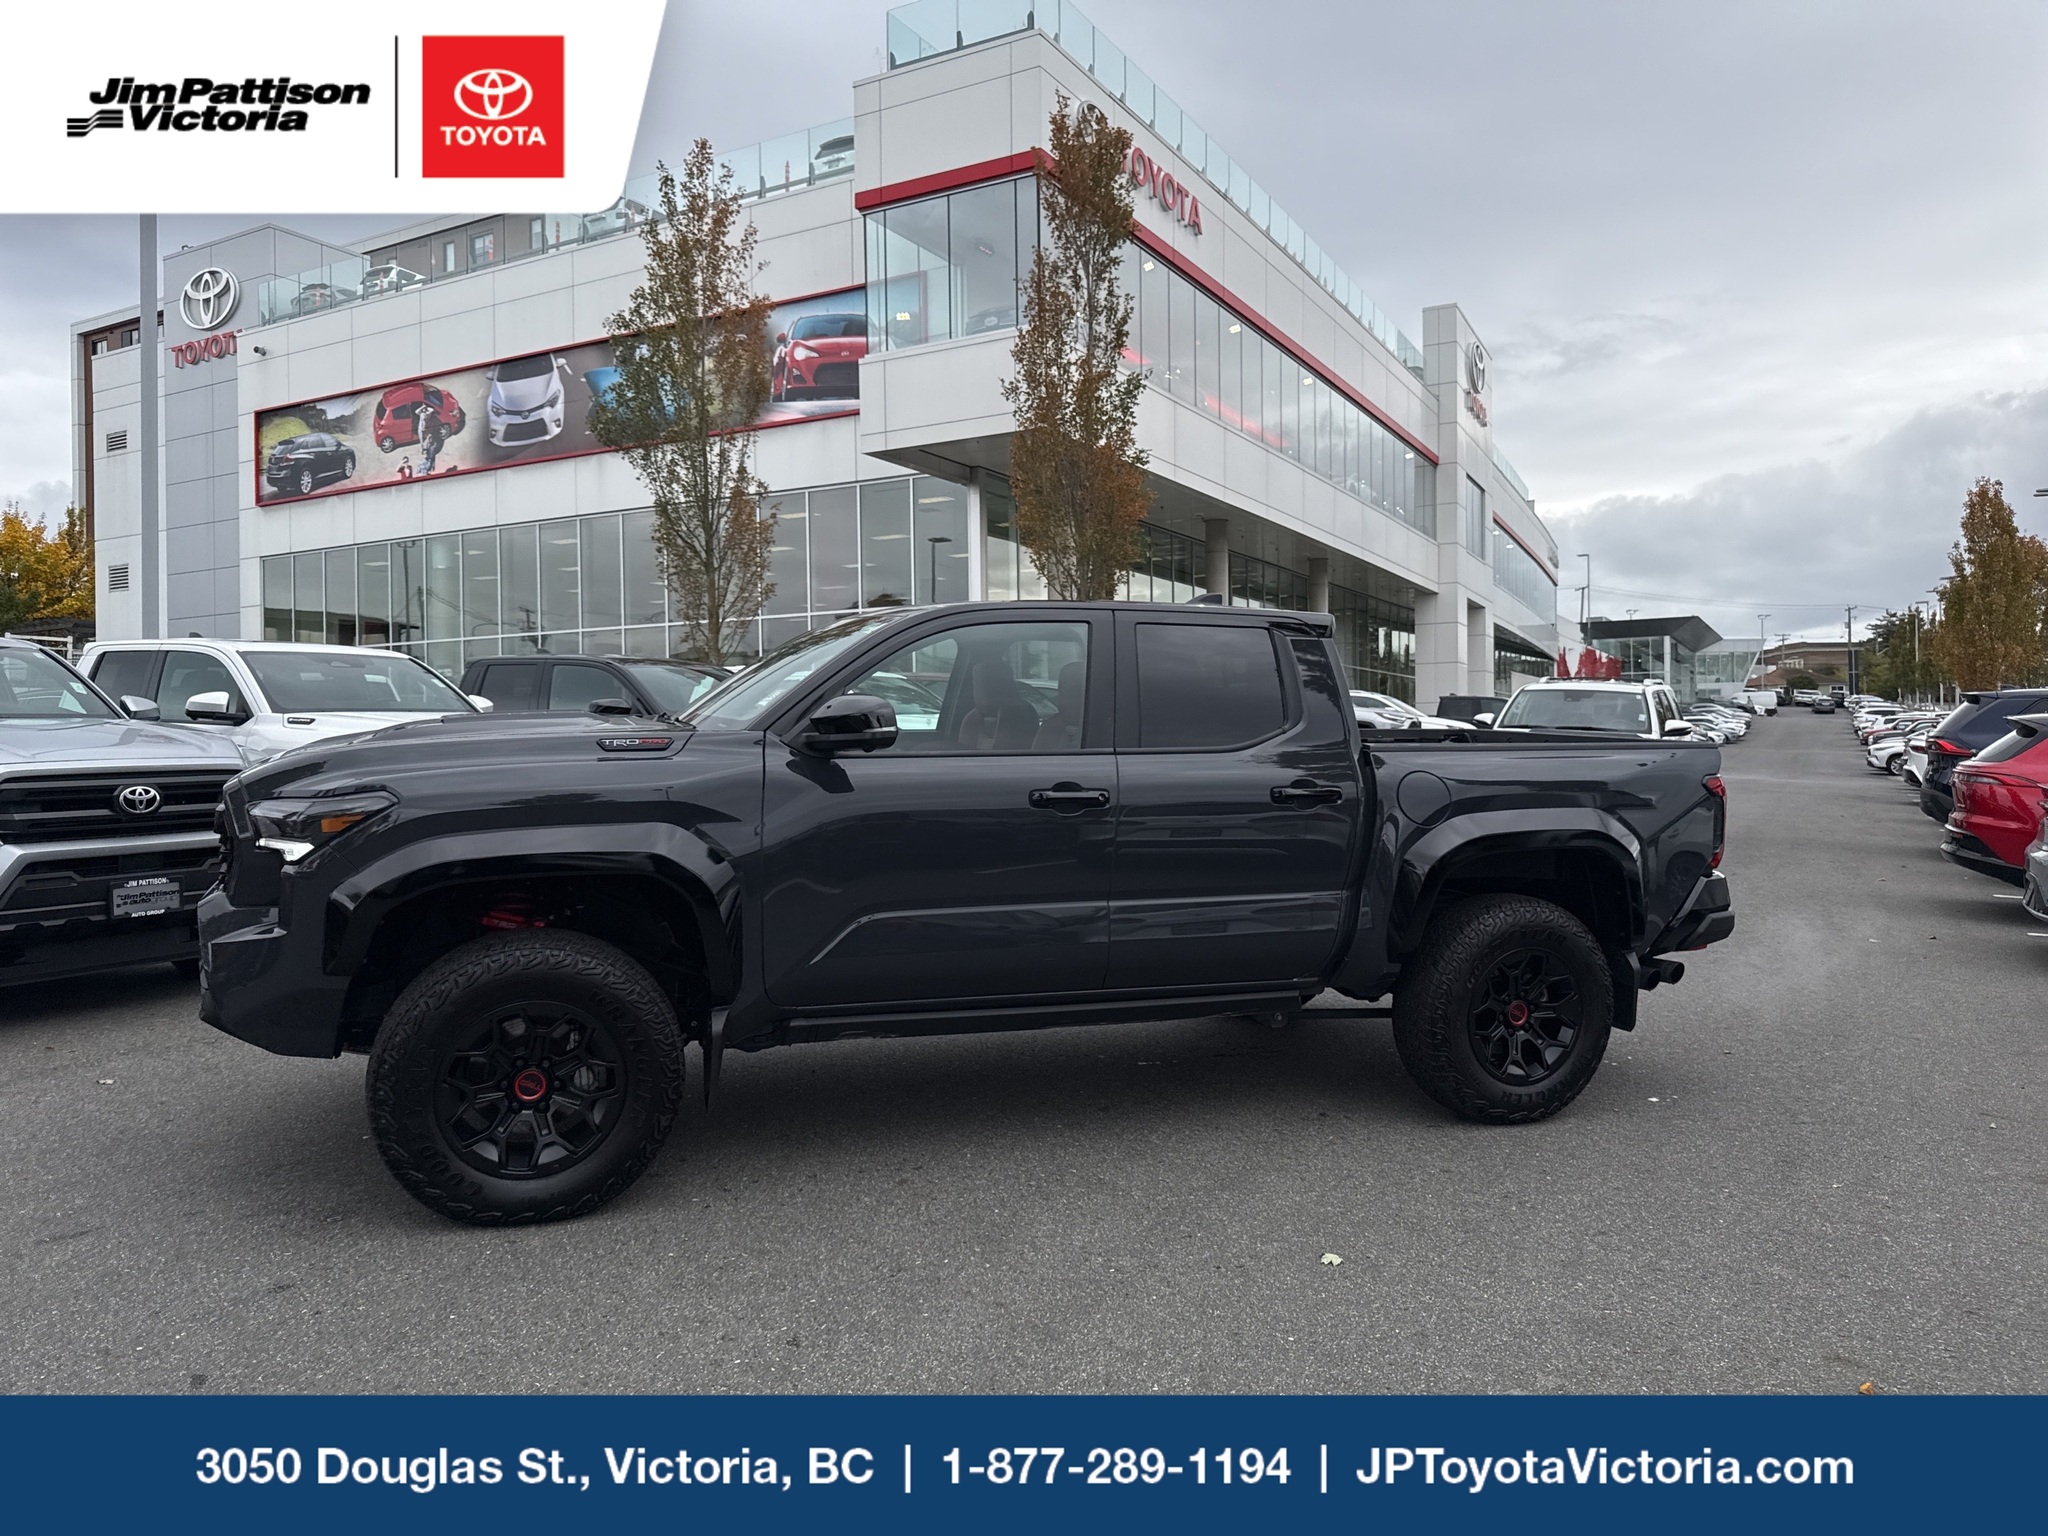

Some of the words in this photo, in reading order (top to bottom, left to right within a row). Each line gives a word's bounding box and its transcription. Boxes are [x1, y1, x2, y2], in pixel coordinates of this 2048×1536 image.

[171, 331, 237, 368] TOYOT
[126, 880, 138, 888] JIM
[138, 877, 167, 886] PATTISON
[146, 908, 166, 916] GROUP
